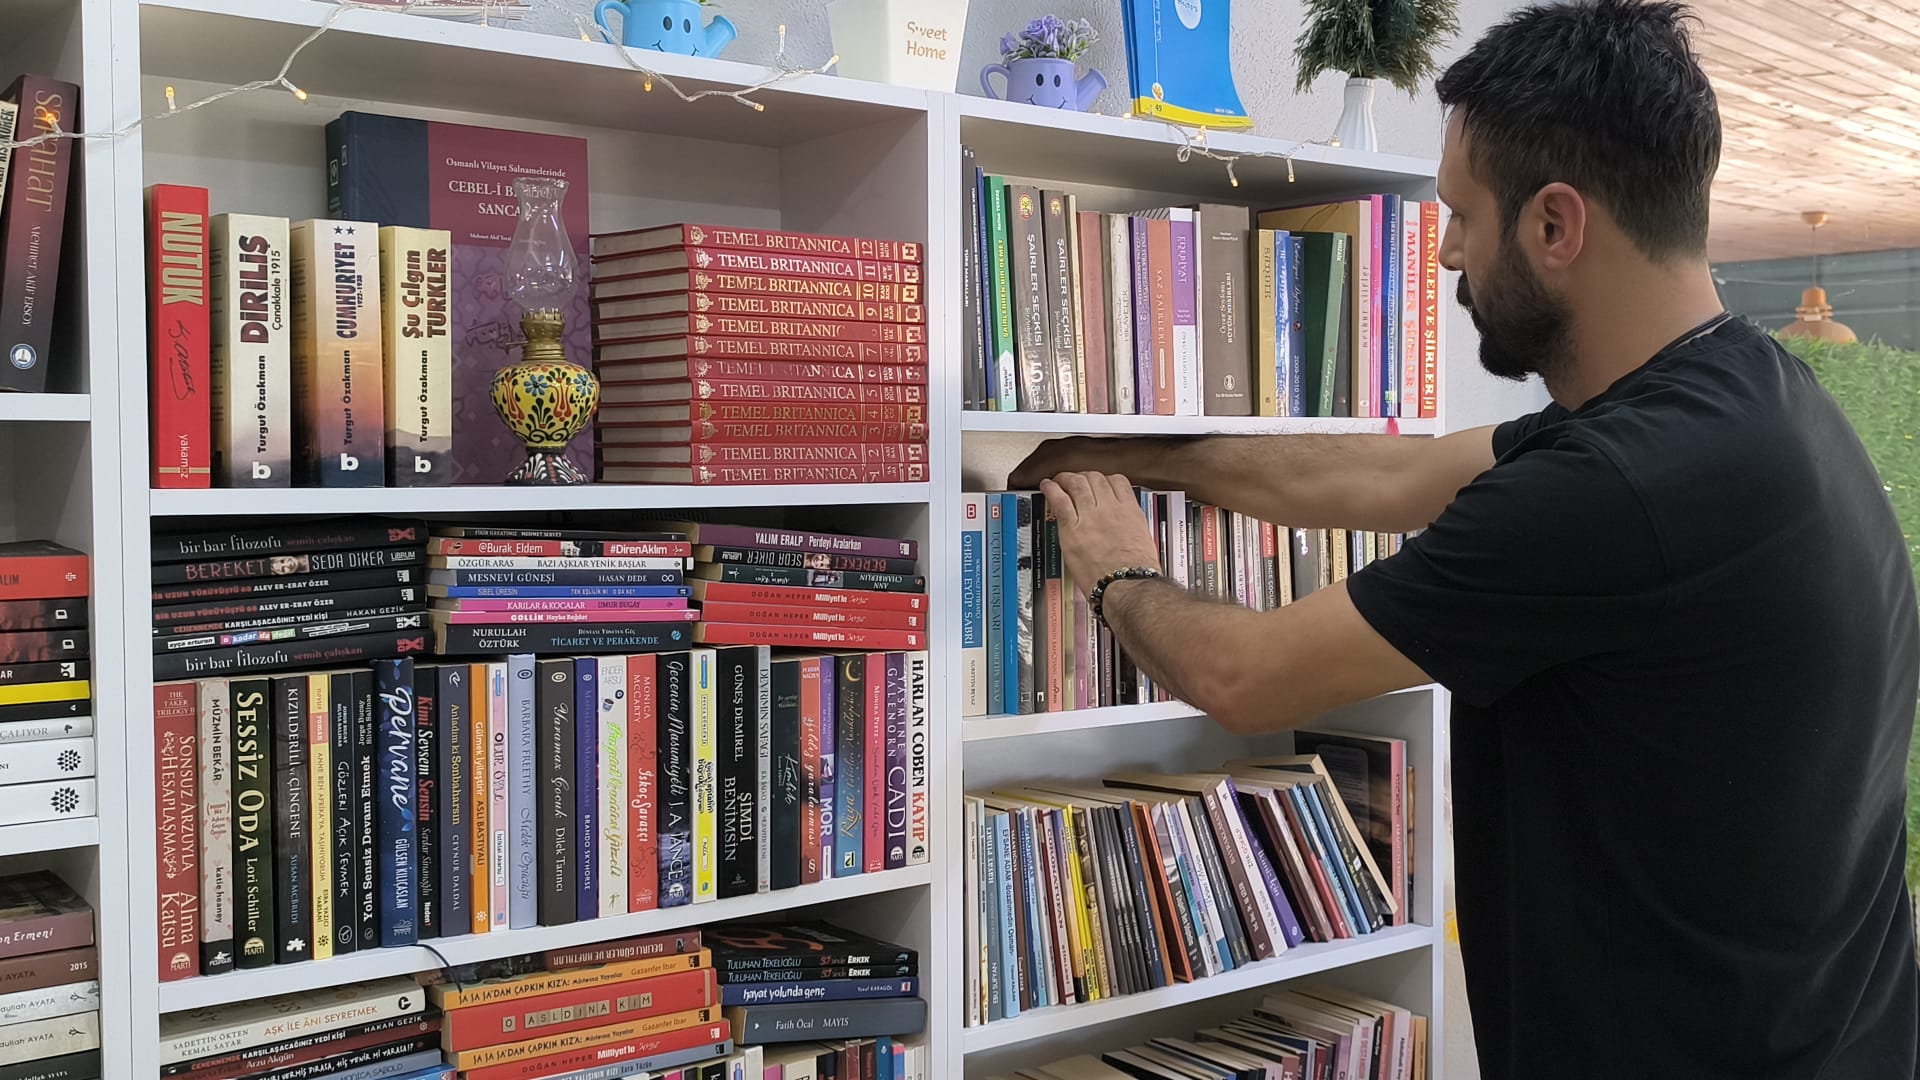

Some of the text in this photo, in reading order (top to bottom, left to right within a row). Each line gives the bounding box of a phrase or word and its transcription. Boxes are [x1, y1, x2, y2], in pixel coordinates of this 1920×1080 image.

[906, 40, 947, 60] Home
[446, 157, 566, 178] Osmanlı Vilayet Salnamelerinde
[449, 180, 500, 194] CEBEL-İ
[713, 231, 762, 248] TEMEL
[766, 235, 850, 254] BRITANNICA
[162, 211, 203, 305] NUTUK
[718, 254, 767, 270] TEMEL
[771, 258, 854, 276] BRITANNICA
[271, 250, 281, 331] Çanakkale 1915
[401, 250, 424, 339] Şu Çılgın
[717, 275, 874, 299] TEMEL BRITANNICA 10
[1027, 234, 1044, 346] ŞAİRLER SEÇKİSİ
[1057, 238, 1072, 348] ŞAİRLER SEÇKİSİ
[719, 297, 768, 312] TEMEL
[772, 300, 855, 317] BRITANNICA
[1424, 223, 1436, 395] MANİLER VE ŞİİRLER
[719, 318, 768, 334] TEMEL
[717, 339, 768, 355] TEMEL
[771, 341, 854, 358] BRITANNICA
[254, 355, 268, 453] Turgut Özakman
[343, 350, 354, 445] Turgut Özakman
[418, 350, 430, 443] Turgut Özakman
[722, 447, 770, 460] TEMEL
[773, 447, 857, 460] BRITANNICA
[722, 468, 858, 481] TEMEL BRITANNICA
[179, 541, 200, 554] bir
[204, 540, 227, 553] bar
[230, 535, 282, 552] filozofu
[478, 543, 543, 554] @Burak_Eldem
[610, 544, 668, 555] #DirenAklım
[755, 532, 861, 550] YALIM ERALP Perdeyi Aralarken
[185, 551, 384, 581] BEREKET SEDA DİKER
[458, 558, 490, 567] ÖZGÜR
[558, 560, 589, 568] AŞKLAR
[590, 559, 616, 568] YENİK
[618, 560, 647, 568] BAŞLAR
[834, 557, 887, 572] BEREKET
[468, 572, 514, 582] MESNEVİ
[517, 572, 555, 583] GÜNEŞİ
[599, 574, 624, 582] HASAN
[963, 534, 975, 645] OHRİLİ EYÜP SABRİ
[472, 628, 527, 637] NURULLAH
[479, 638, 520, 648] ÖZTÜRK
[551, 636, 659, 646] TİCARET VE PERAKENDE
[642, 676, 650, 720] MONICA
[734, 664, 744, 762] GÜNEŞ DEMİREL
[379, 686, 412, 811] Pervane
[418, 696, 434, 822] Kimi Sevsem Sensin
[552, 702, 569, 819] Yaramaz Çocuk
[912, 660, 924, 842] HARLAN COBEN KAYIP
[236, 691, 265, 852] SESSİZ ODA
[287, 688, 301, 840] KIZILDERİLİ ÇİNGENE
[161, 755, 179, 858] HESAPLAŞMA
[179, 735, 195, 872] SONSUZ ARZUYLA
[888, 766, 906, 839] CADI
[724, 776, 736, 862] BENİMSİN
[737, 792, 753, 841] ŞİMDİ
[820, 797, 832, 836] MOR
[361, 755, 373, 921] Yola Sensiz Devam Etmek
[246, 858, 259, 932] Lori Schiller
[161, 893, 180, 949] Katsu
[180, 890, 198, 945] Alma
[70, 962, 88, 971] 2015
[727, 955, 870, 970] TULUHAN TEKELİOĞLU ERKEK
[728, 968, 871, 983] TULUHAN TEKELİOĞLU ERKEK
[30, 999, 56, 1009] AYATA
[743, 986, 826, 1003] hayat yolunda genç
[775, 1017, 849, 1031] Fatih Öcal MAYIS
[28, 1034, 54, 1043] AYATA
[173, 1029, 249, 1050] SADETTİN ÖKTEN
[181, 1039, 242, 1057] KEMAL SAYAR
